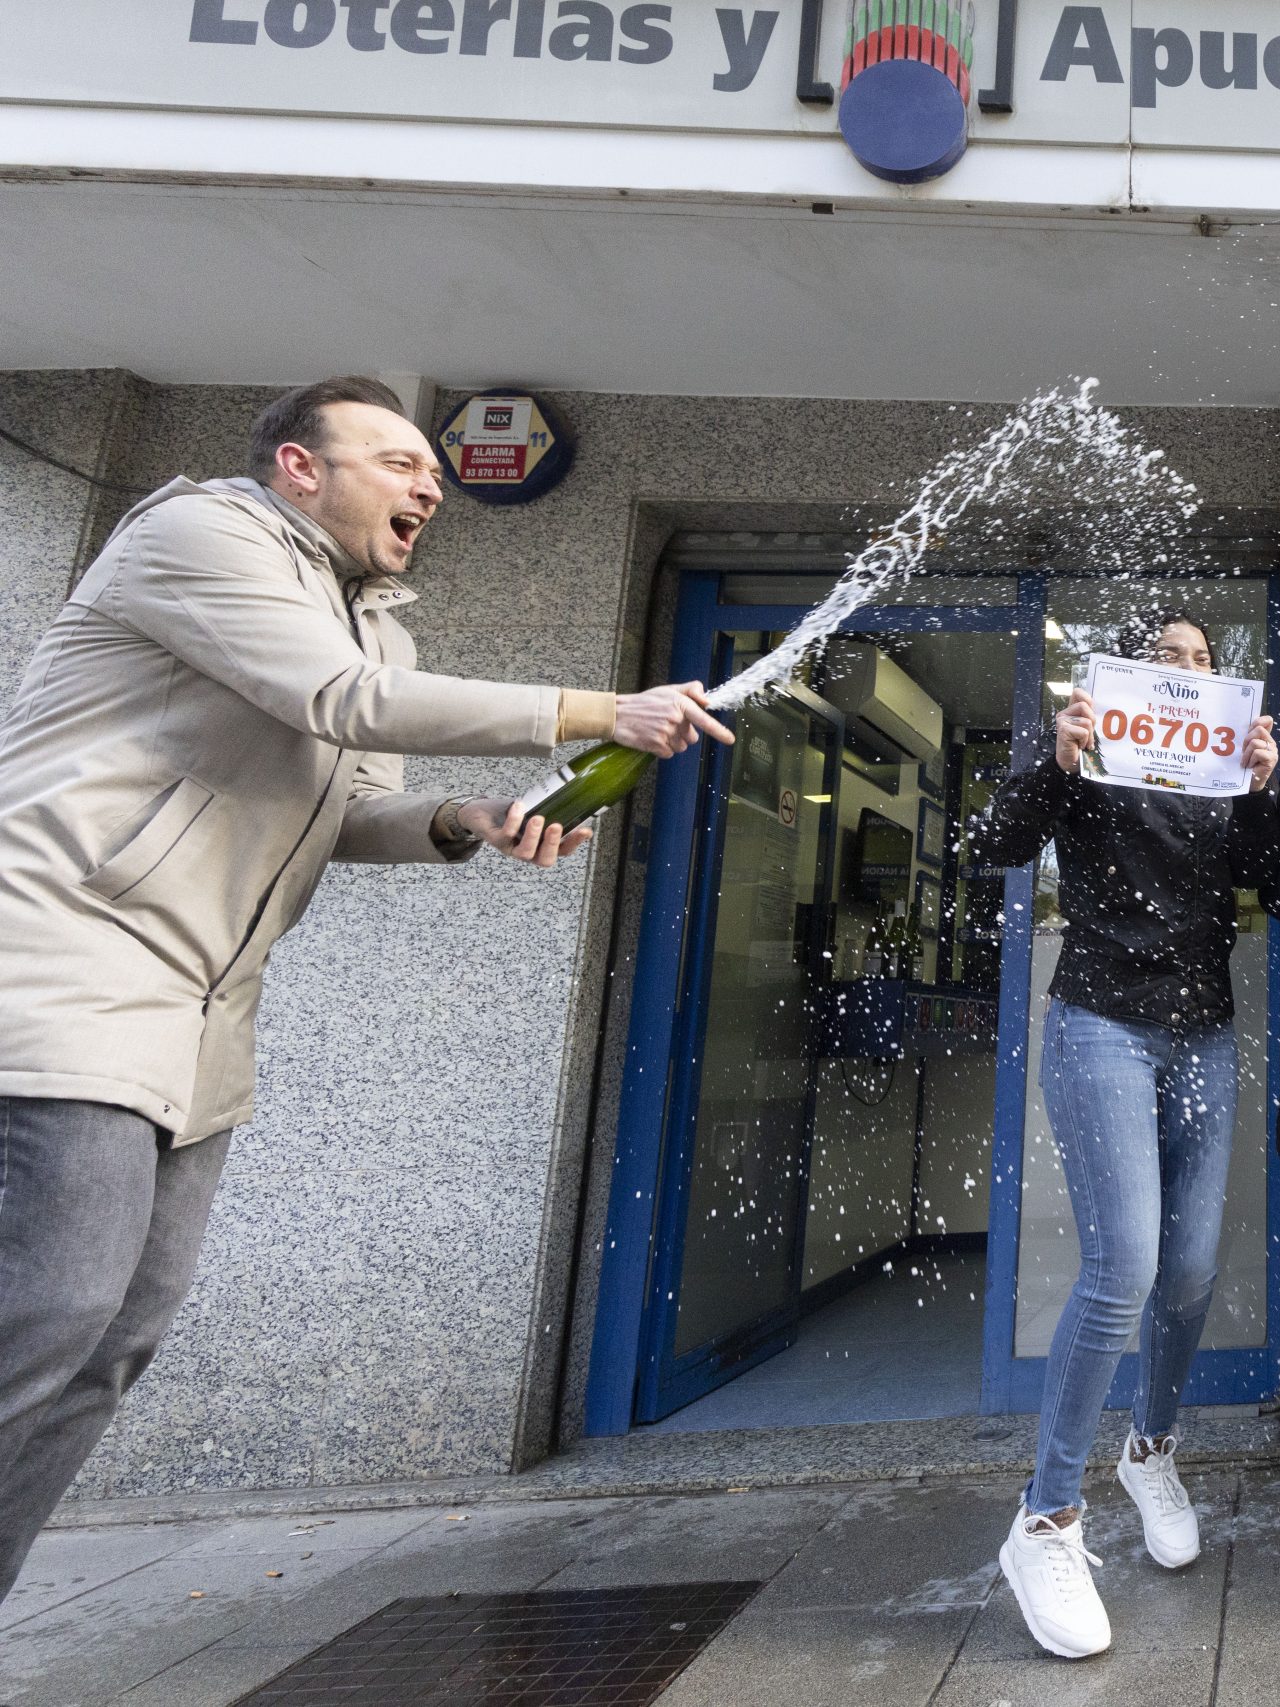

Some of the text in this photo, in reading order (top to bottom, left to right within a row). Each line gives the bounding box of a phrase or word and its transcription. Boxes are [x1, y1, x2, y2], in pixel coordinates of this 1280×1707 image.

[713, 8, 780, 92] y
[531, 431, 547, 448] 11
[472, 447, 516, 456] ALARMA
[465, 468, 518, 477] 93 870 13 00
[1160, 680, 1199, 700] Niño
[1159, 703, 1200, 719] PREMI
[1102, 709, 1236, 757] 06703
